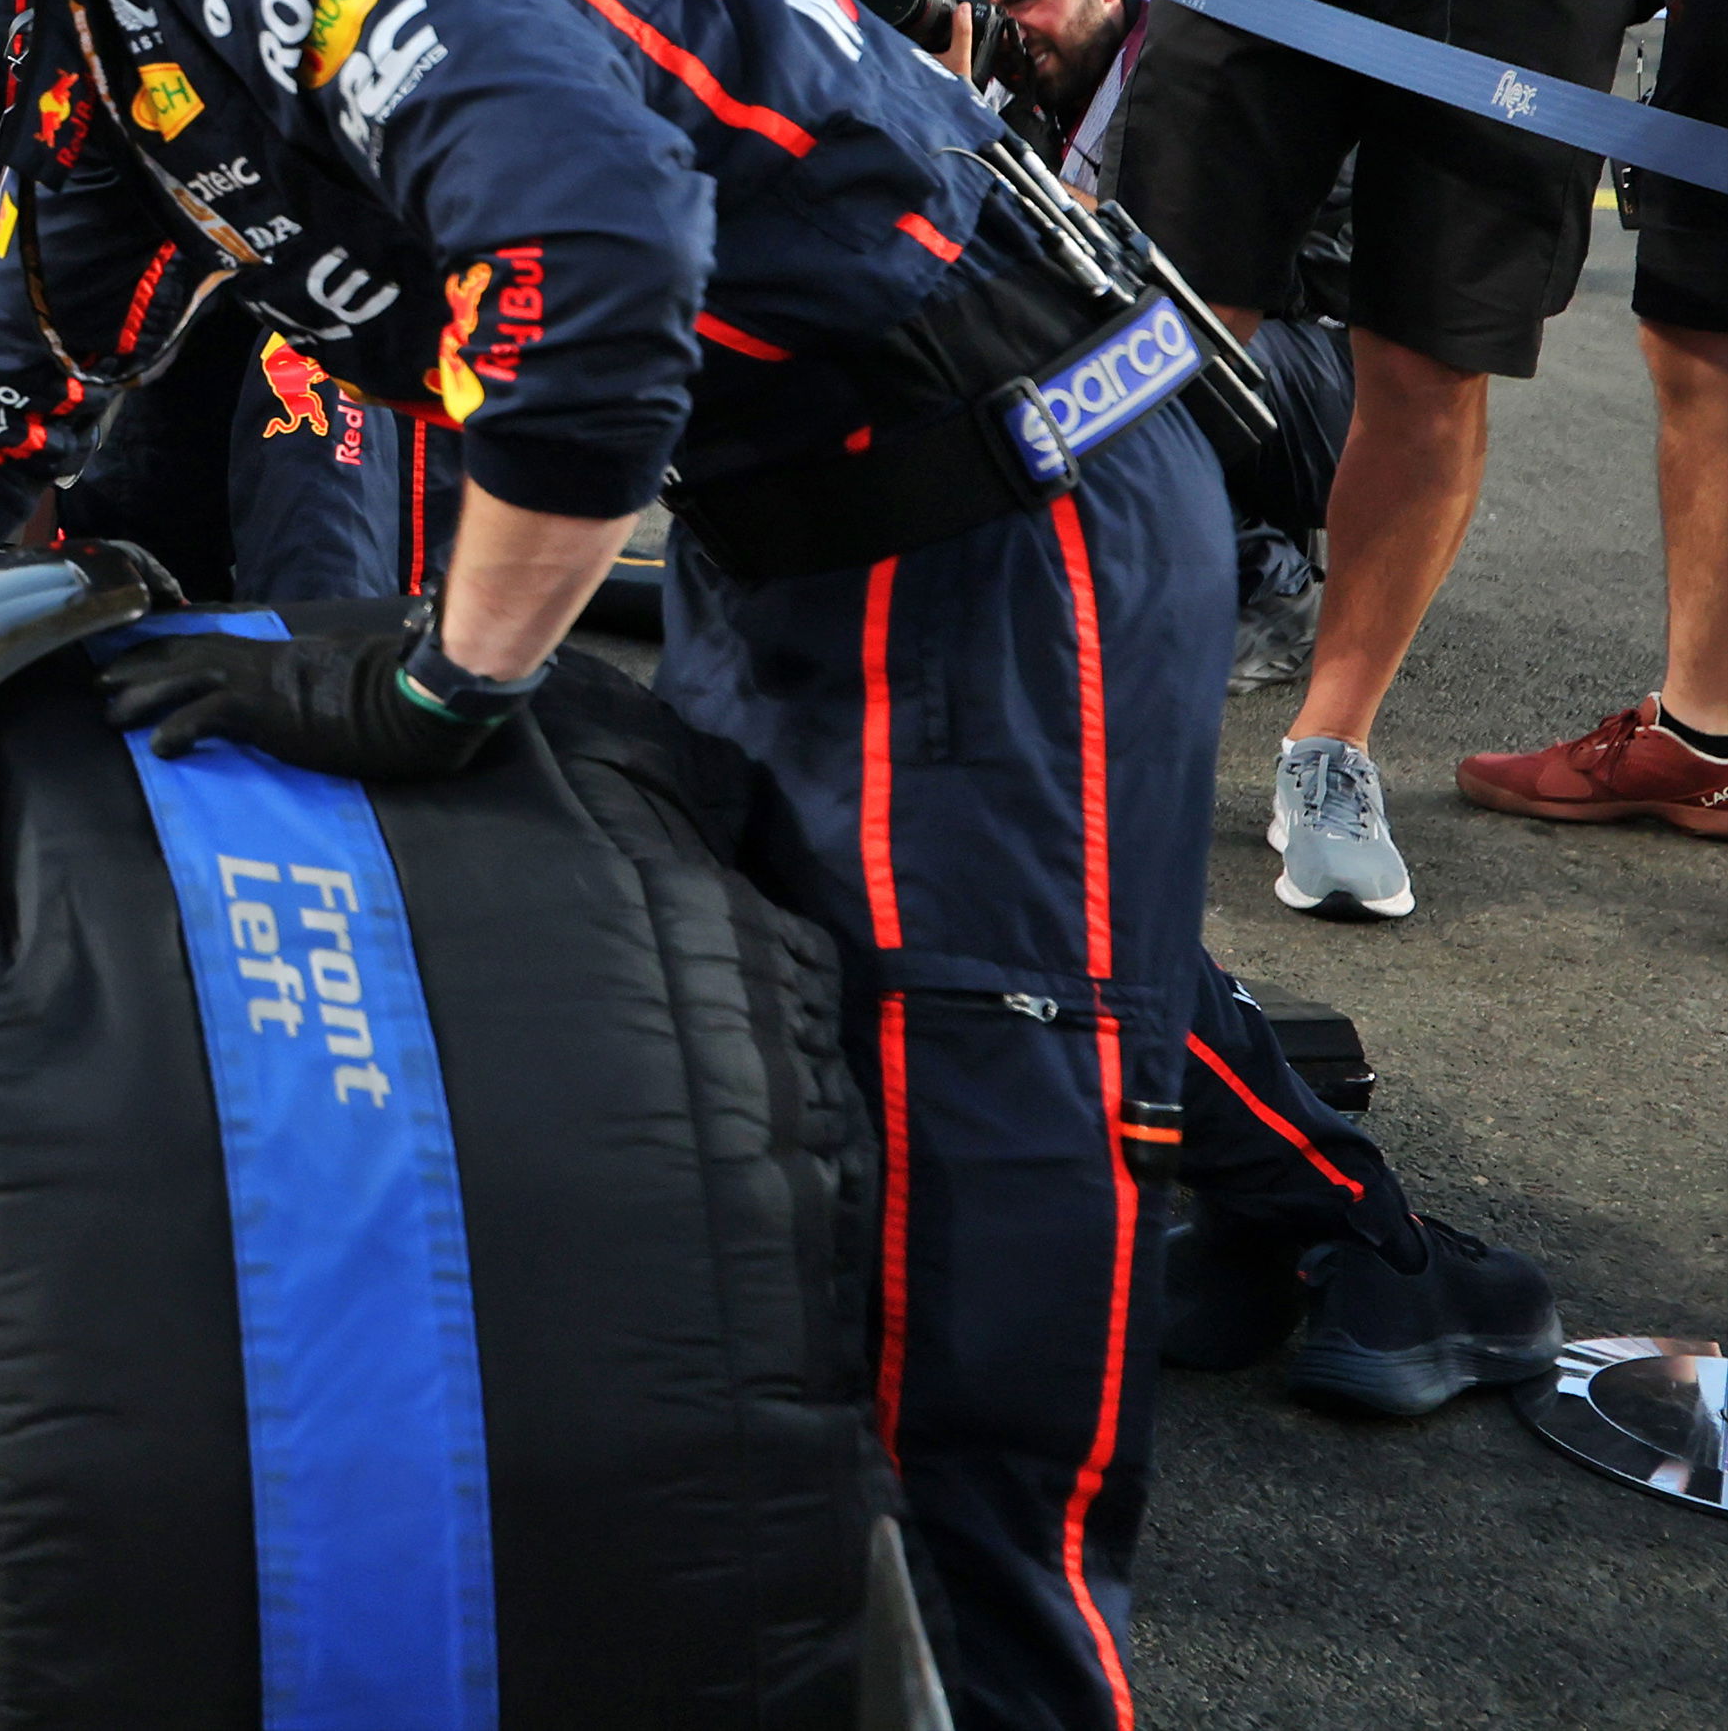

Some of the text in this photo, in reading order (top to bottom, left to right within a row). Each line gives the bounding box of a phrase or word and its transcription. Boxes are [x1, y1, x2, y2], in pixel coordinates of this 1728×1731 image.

[1022, 305, 1188, 480] sparco
[216, 853, 306, 1038] Left
[289, 863, 392, 1109] Front
